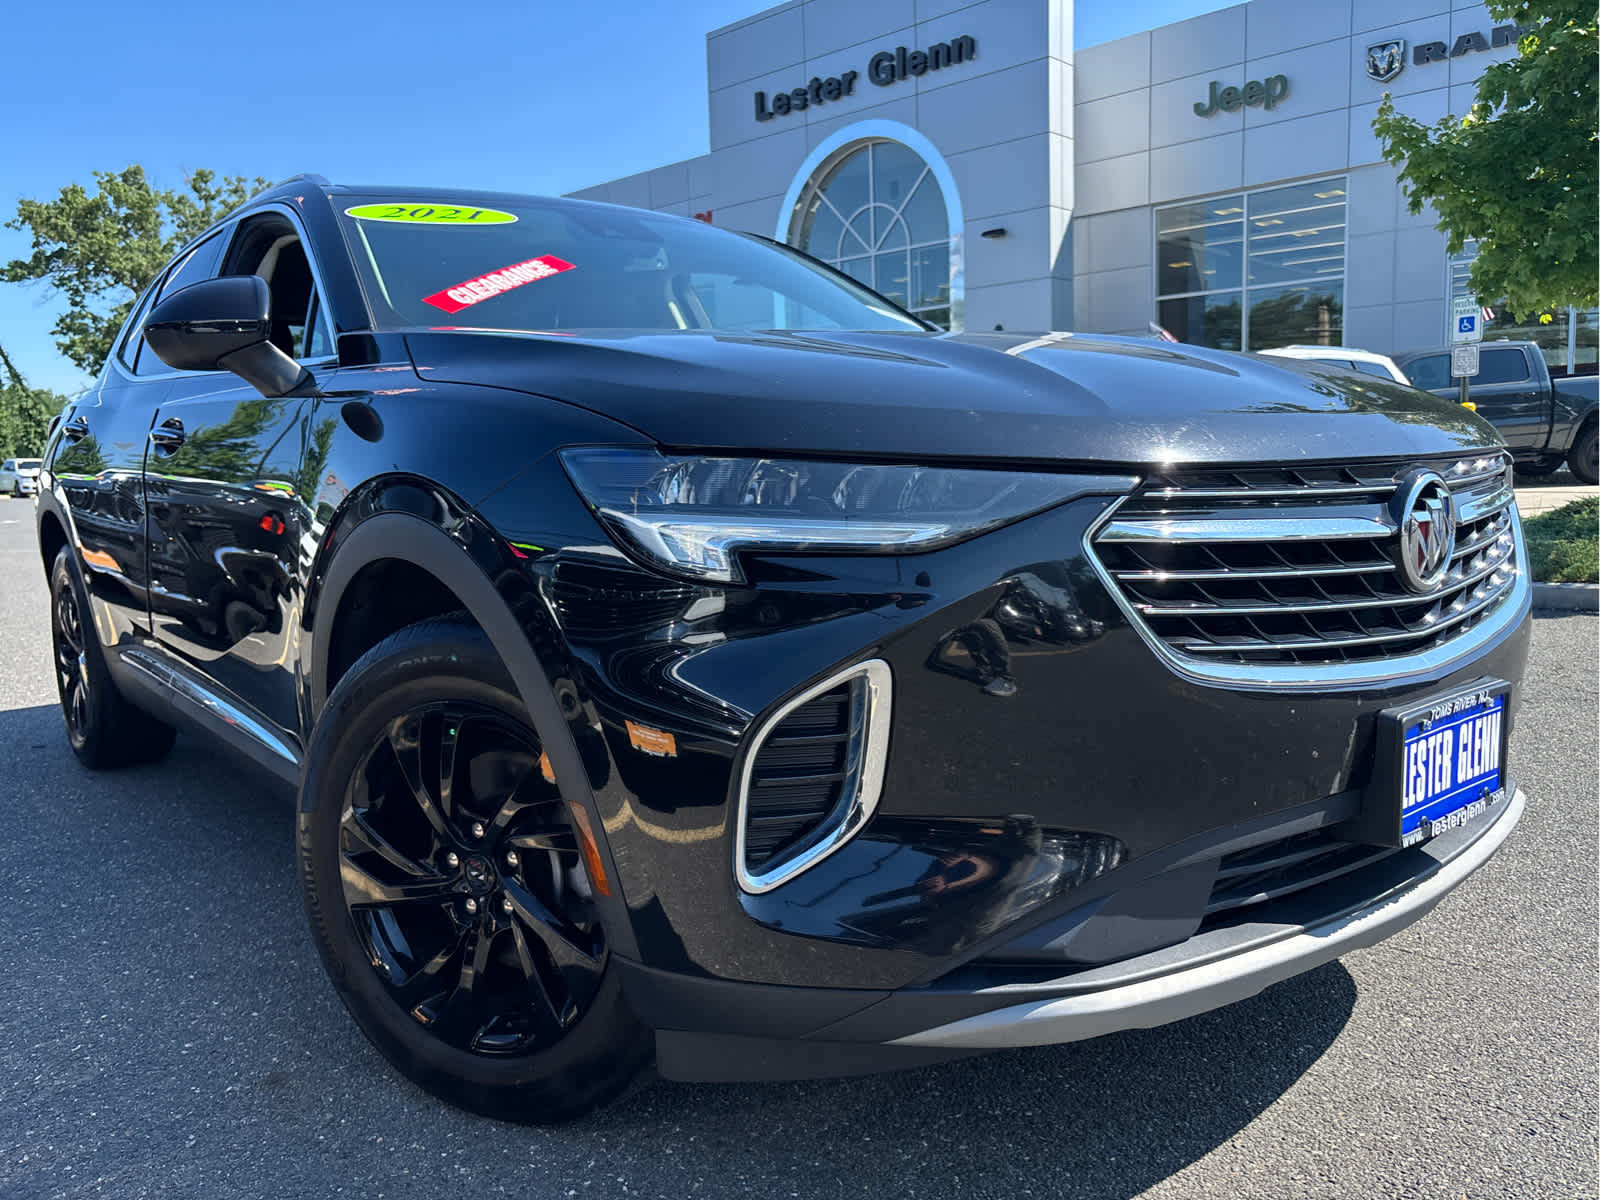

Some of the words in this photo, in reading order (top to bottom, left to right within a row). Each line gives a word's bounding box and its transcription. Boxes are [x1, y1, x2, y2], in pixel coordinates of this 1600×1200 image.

[1413, 24, 1524, 66] RAM
[754, 66, 857, 122] Lester
[868, 32, 976, 87] Glenn
[1192, 73, 1289, 118] Jeep
[380, 206, 484, 221] 2021
[447, 260, 559, 305] CLEARANCE
[1431, 702, 1453, 721] TOMS
[1402, 729, 1453, 809] LESTER
[1457, 711, 1501, 784] GLENN
